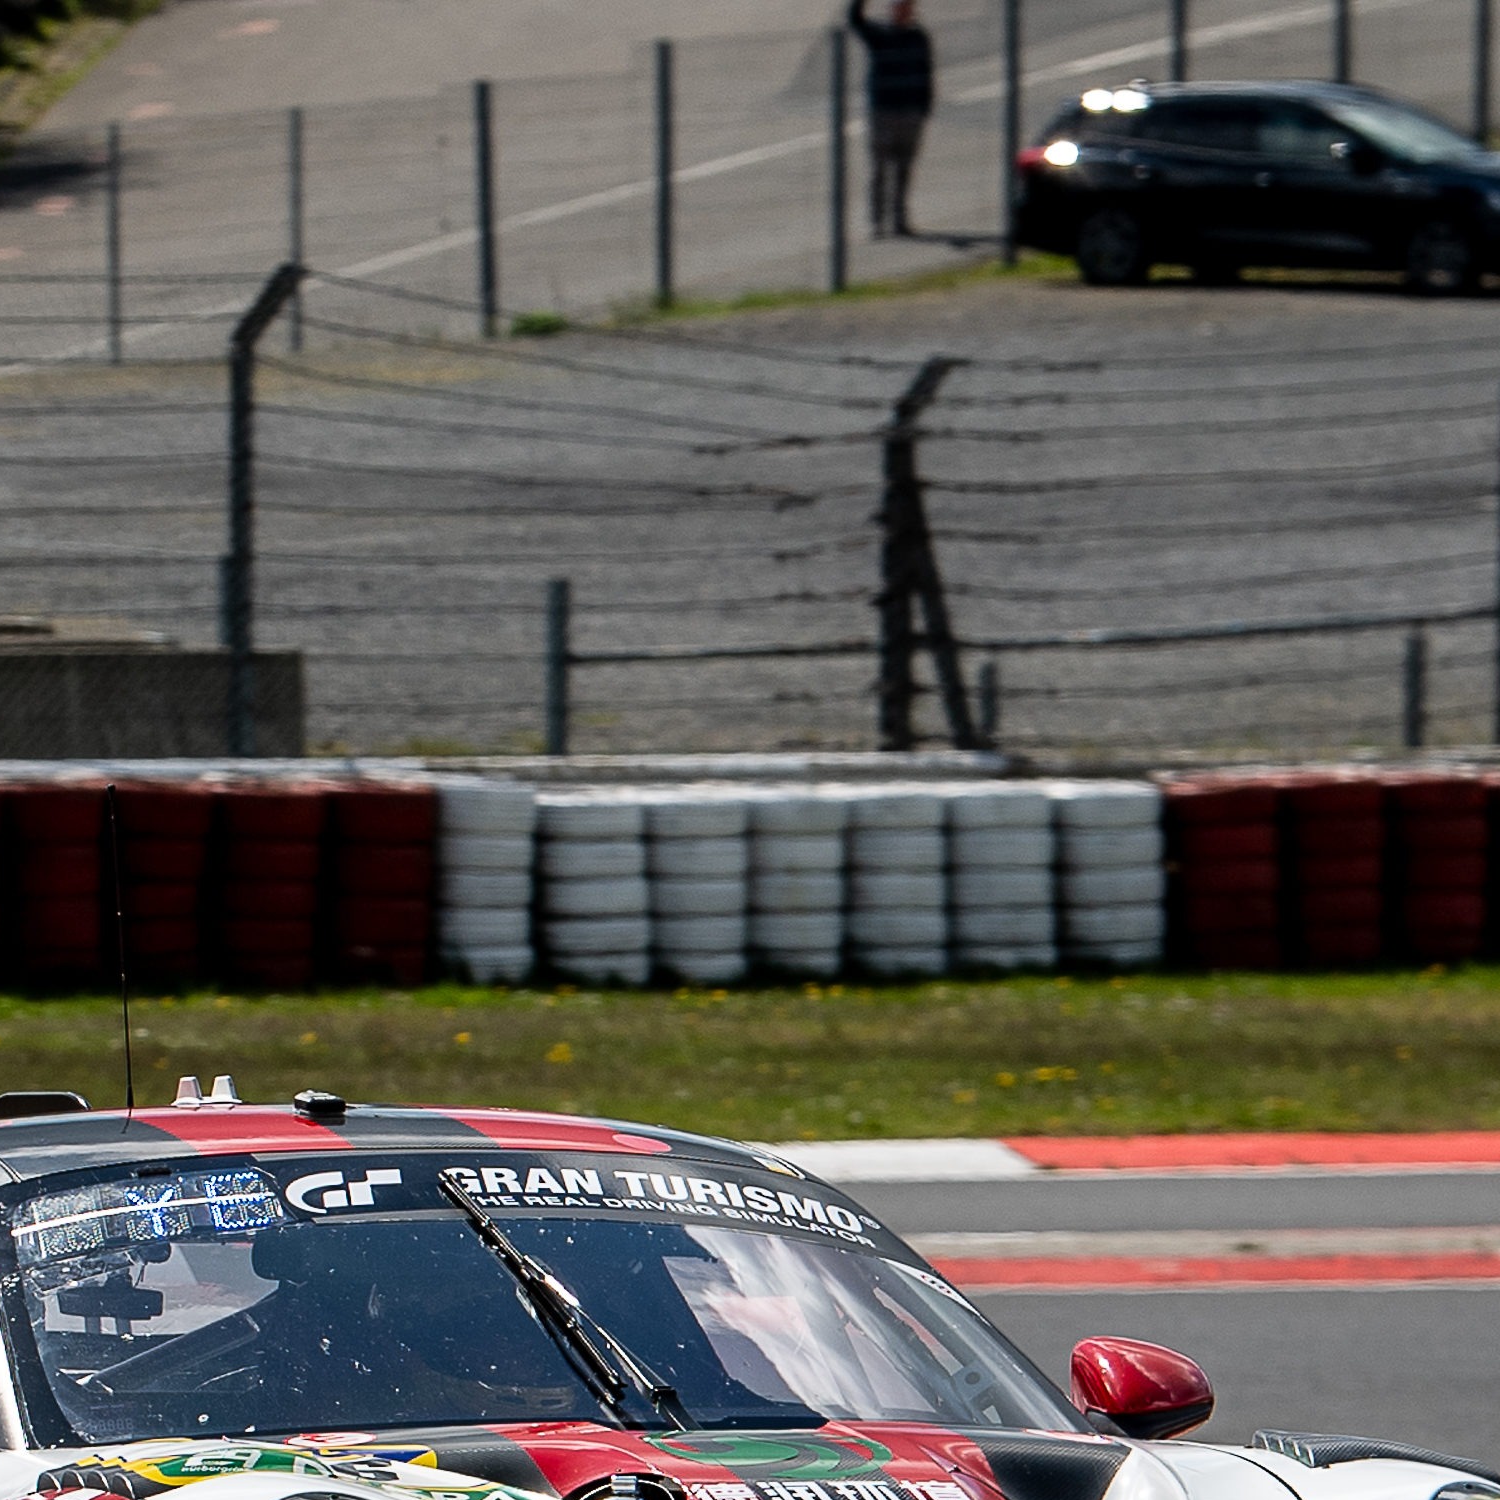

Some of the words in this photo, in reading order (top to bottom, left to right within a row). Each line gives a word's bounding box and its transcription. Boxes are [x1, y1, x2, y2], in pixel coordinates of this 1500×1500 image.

[443, 1167, 604, 1195] GRAN
[523, 1195, 601, 1208] REAL
[603, 1198, 718, 1216] DRIVING
[721, 1207, 877, 1248] SIMULATOR
